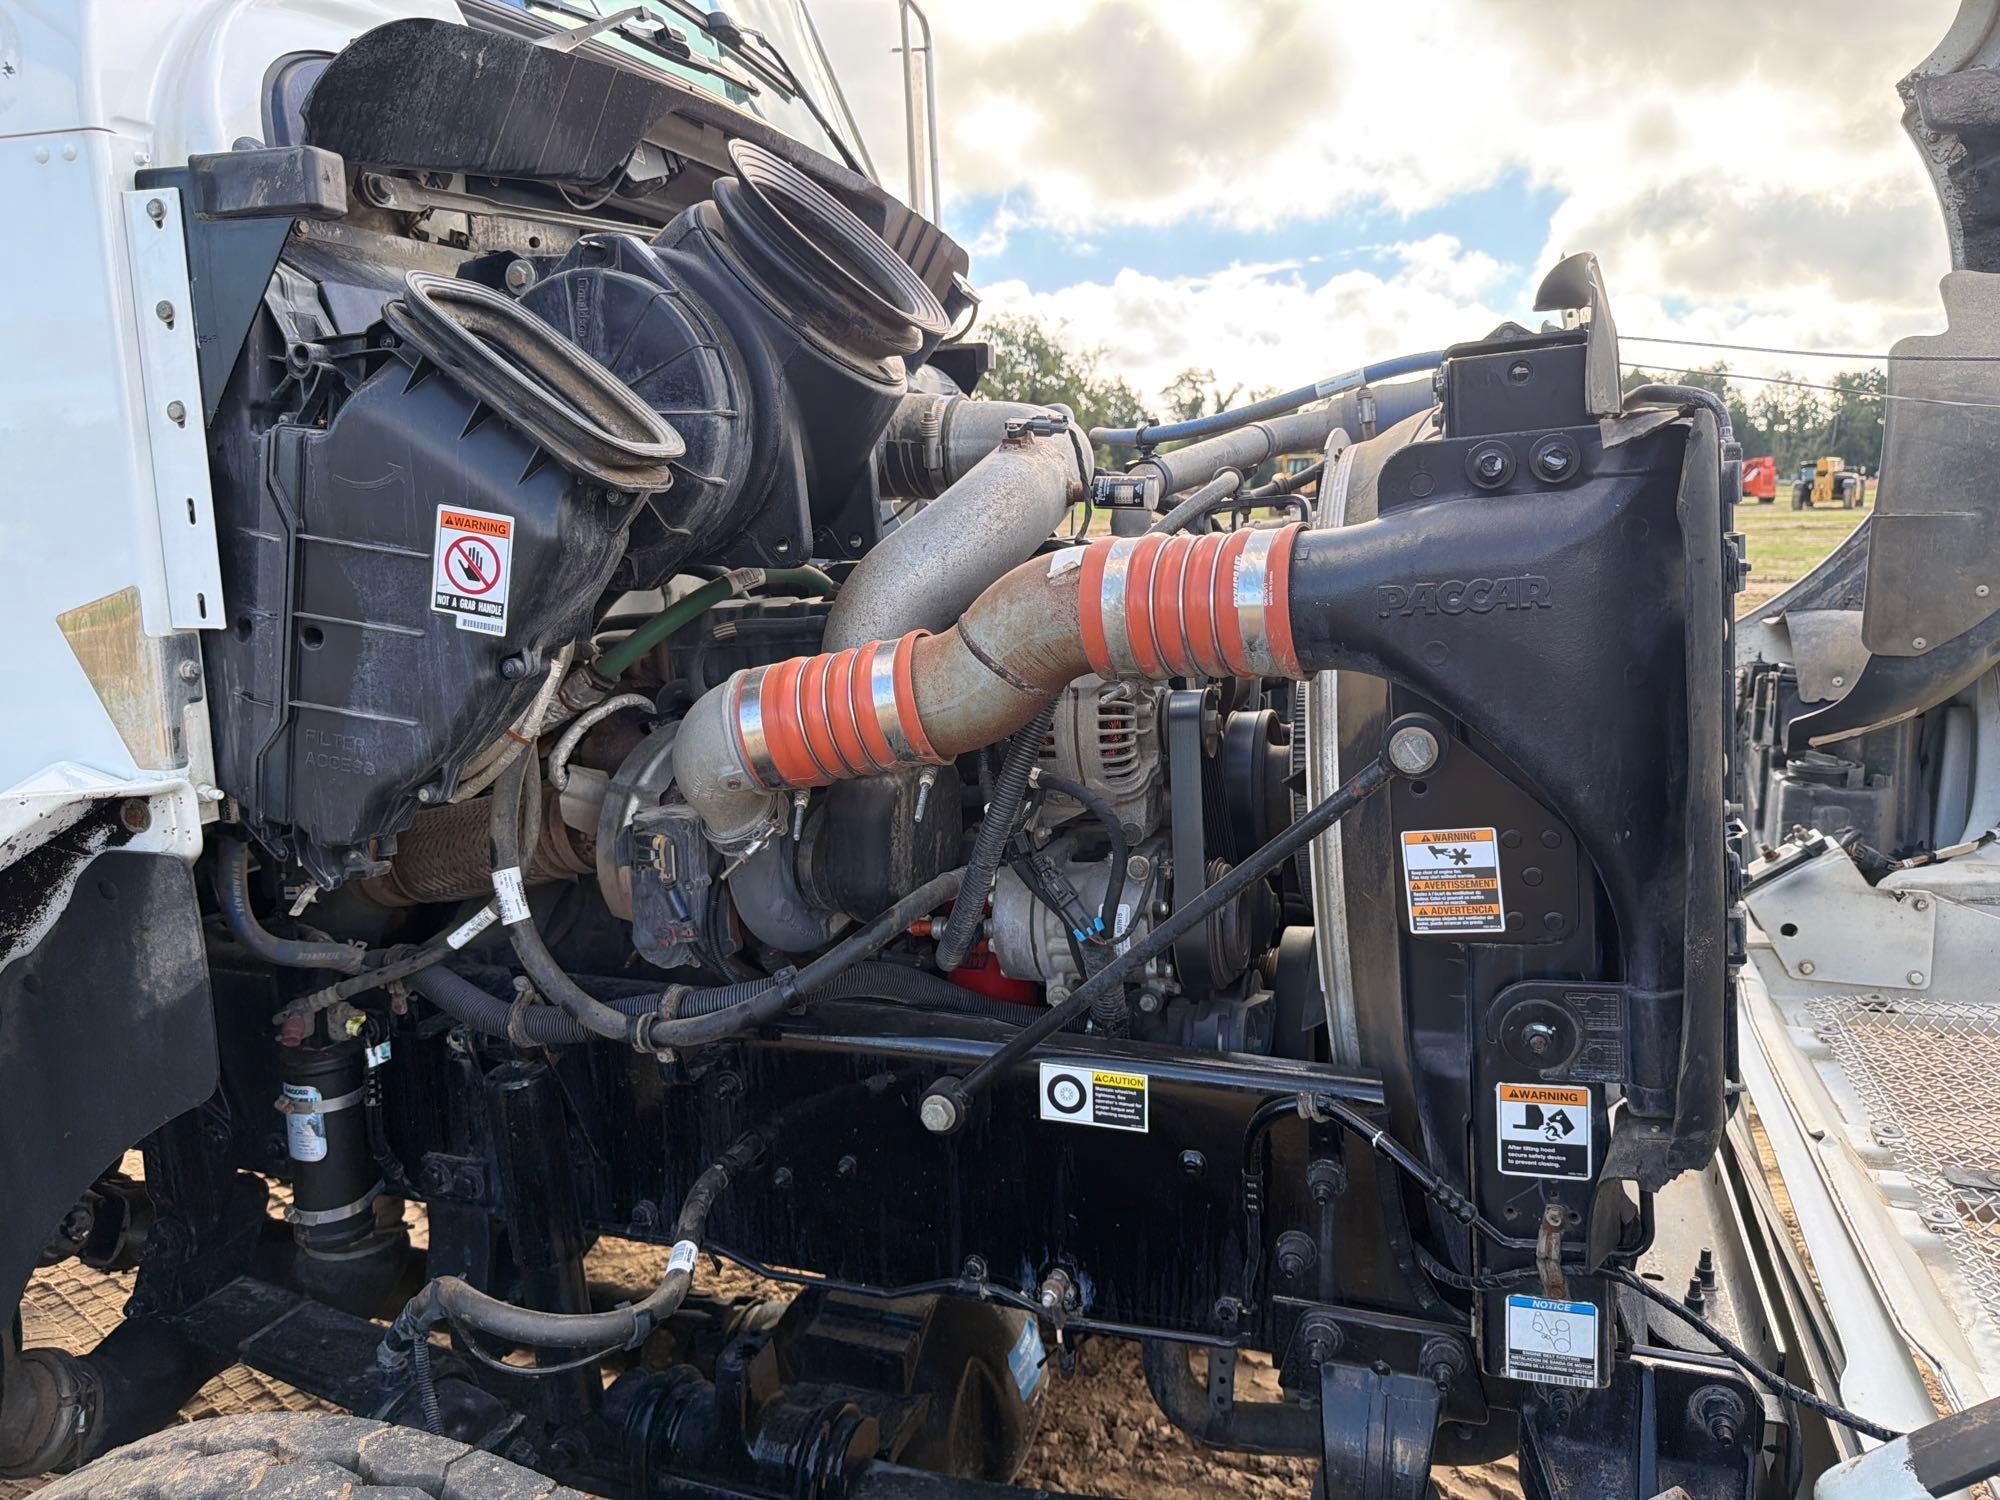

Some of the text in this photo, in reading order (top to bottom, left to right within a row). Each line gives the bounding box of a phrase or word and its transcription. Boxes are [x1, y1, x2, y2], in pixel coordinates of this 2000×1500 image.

[454, 517, 506, 534] WARNING
[1376, 576, 1552, 617] PACCAR
[437, 595, 502, 616] NOT A GRAB HANDLE
[305, 728, 367, 753] FILTER
[305, 752, 376, 776] ACCESS
[1433, 832, 1477, 841] WARNING
[1424, 880, 1495, 889] AVERTISSEMENT
[1431, 906, 1494, 915] ADVERTENCIA
[1102, 1075, 1143, 1086] CAUTION
[1519, 1091, 1578, 1101] WARNING
[1532, 1300, 1572, 1311] NOTICE
